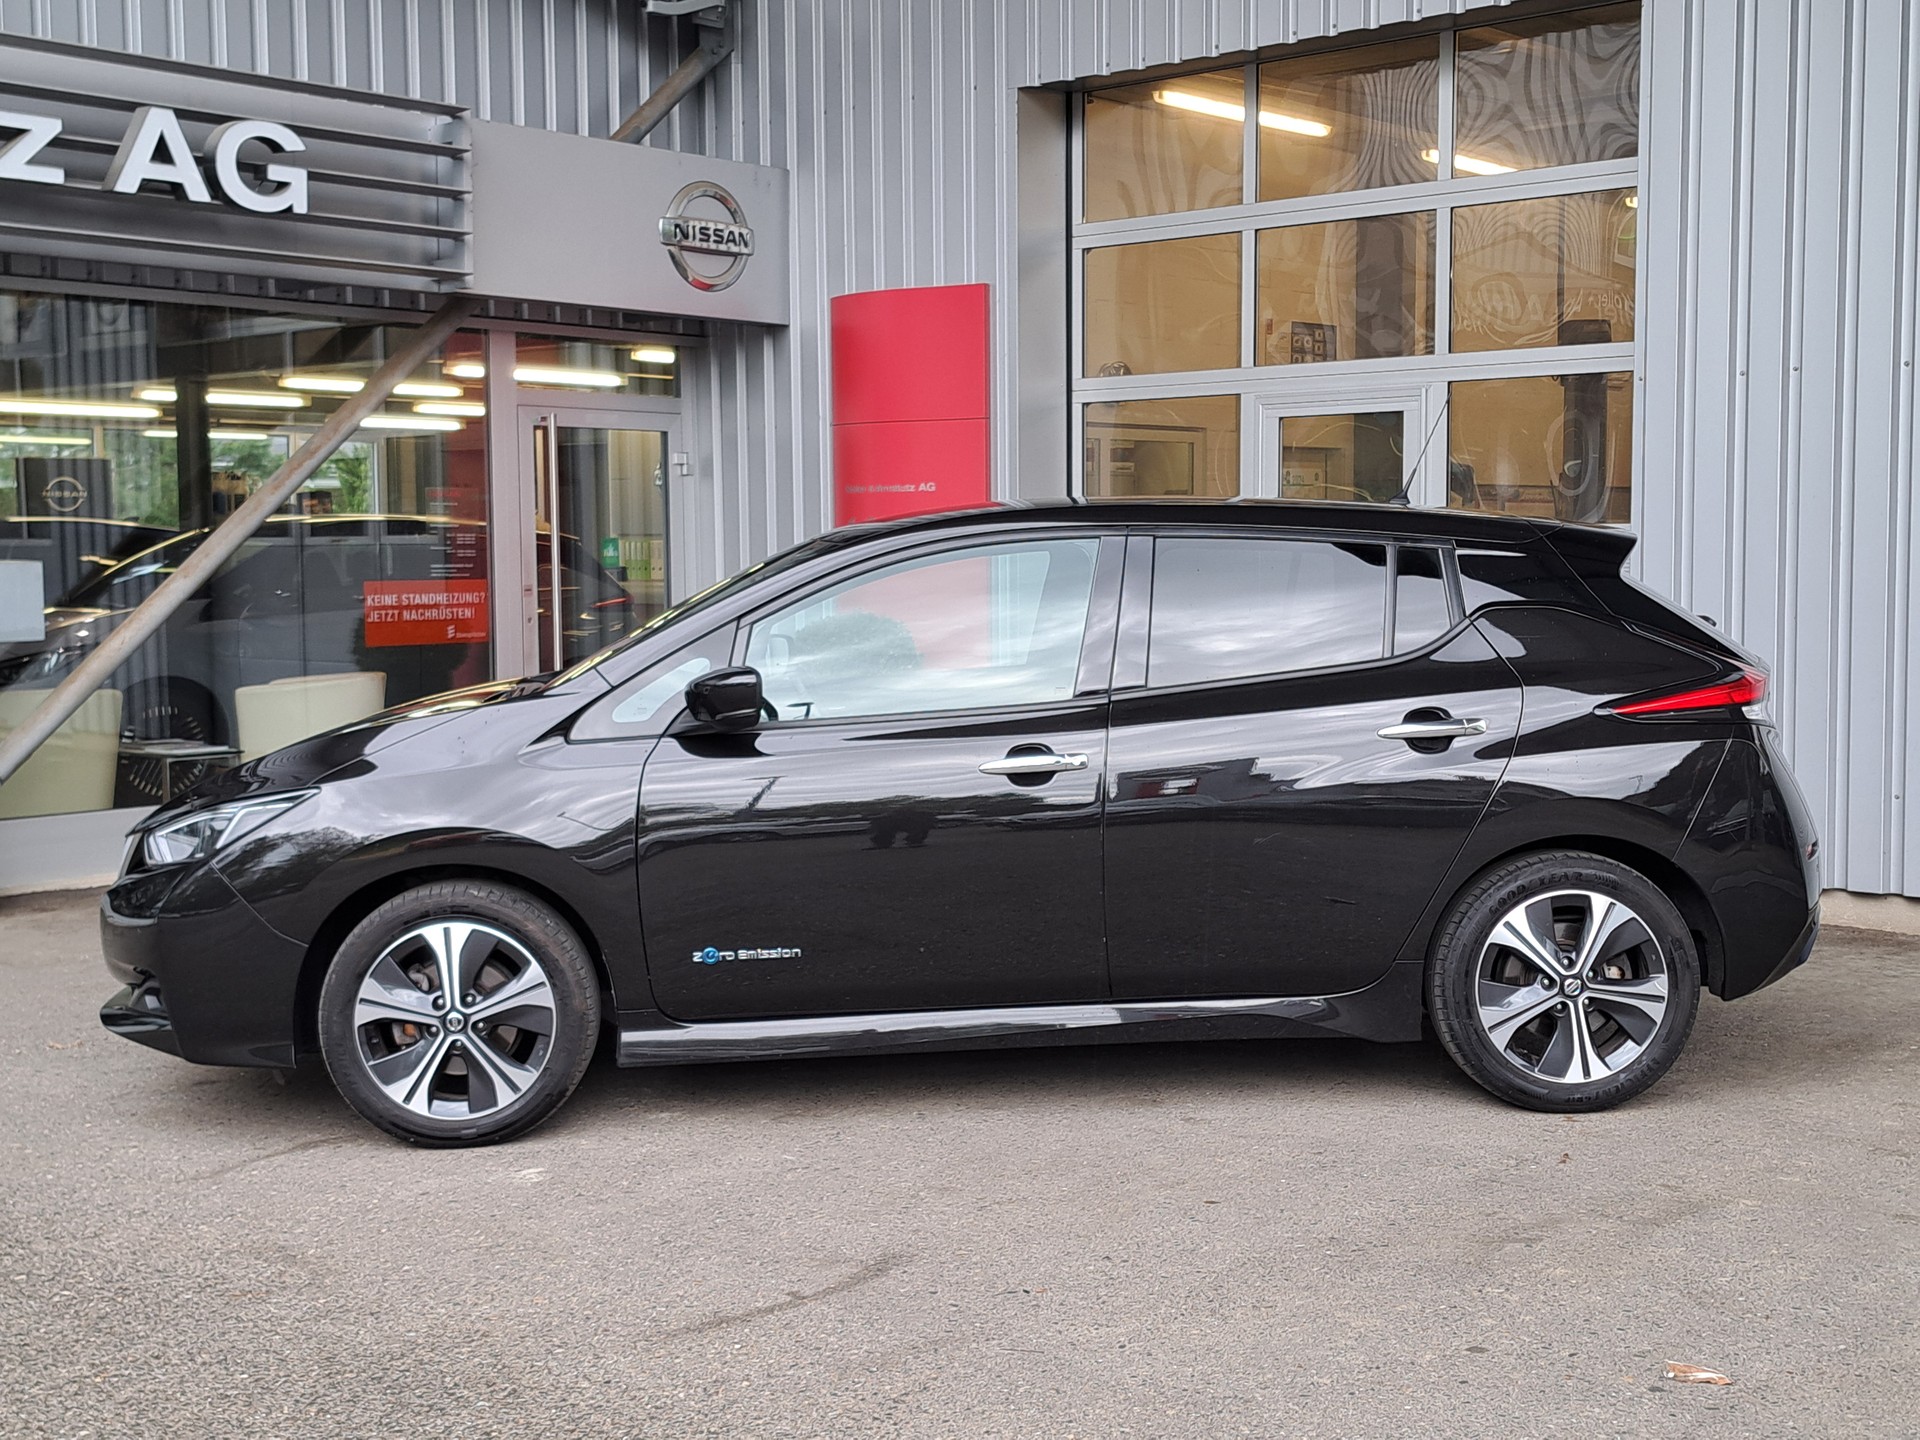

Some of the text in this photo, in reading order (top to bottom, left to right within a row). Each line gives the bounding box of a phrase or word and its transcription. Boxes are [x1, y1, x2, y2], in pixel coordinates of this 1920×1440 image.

[108, 106, 309, 215] AG
[673, 223, 749, 249] NISSAN
[367, 592, 486, 606] KEINE STANDHEIZUNG?
[367, 606, 476, 622] JETZT NACHRÜSTEN!
